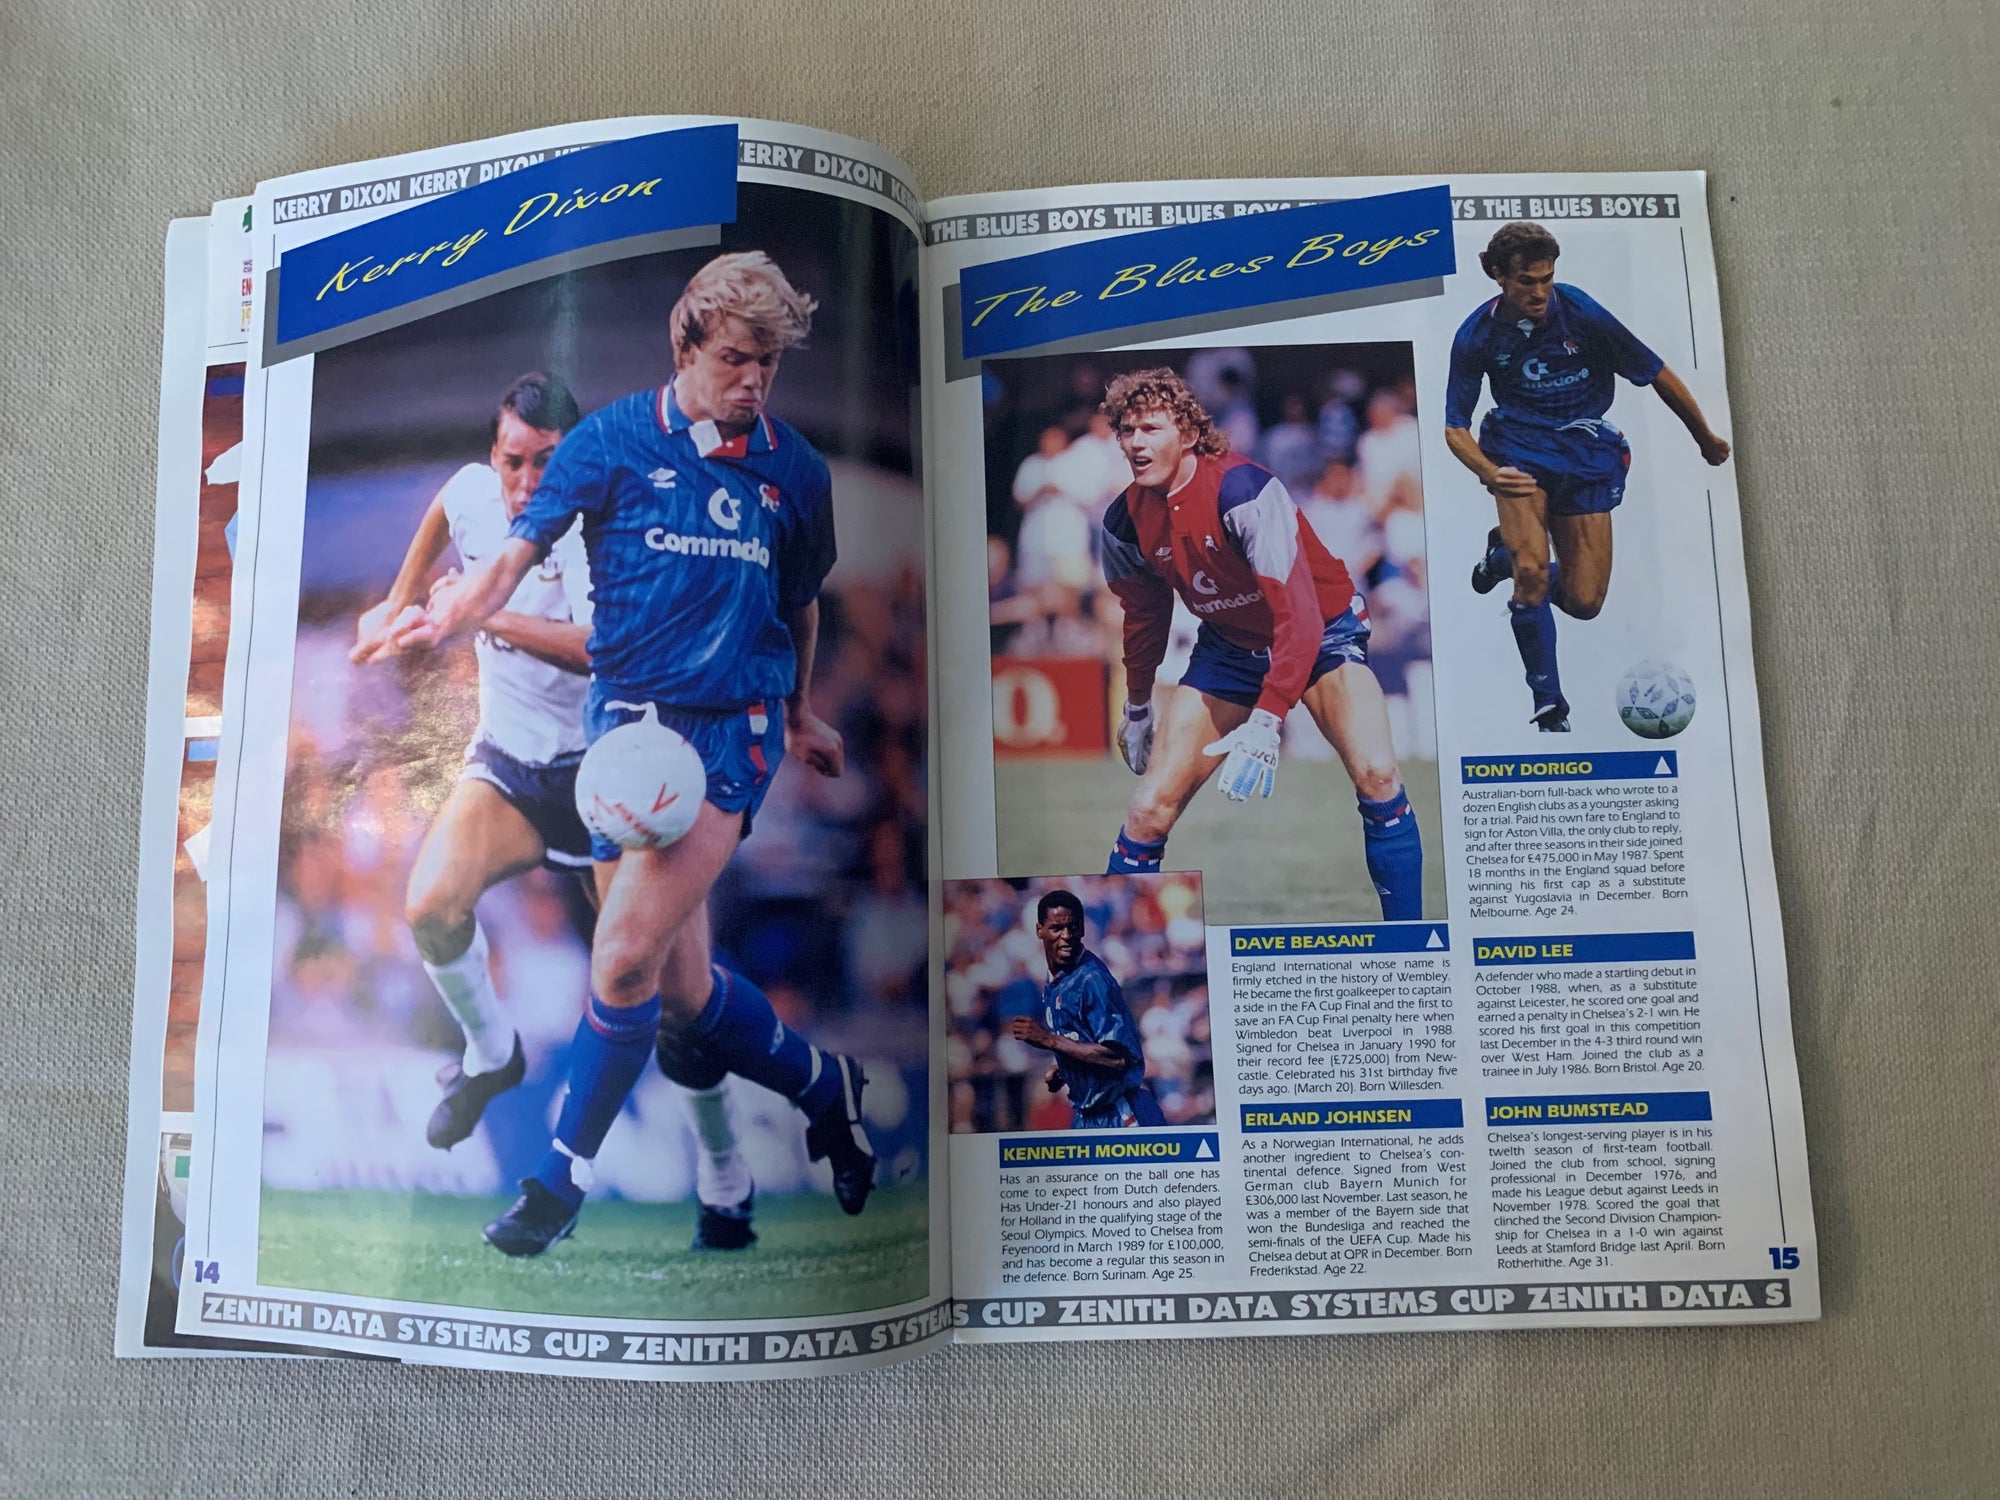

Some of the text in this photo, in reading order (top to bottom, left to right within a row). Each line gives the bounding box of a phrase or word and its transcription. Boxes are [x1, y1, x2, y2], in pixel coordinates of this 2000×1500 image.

[275, 192, 333, 222] KERRY
[340, 180, 400, 210] DIXON
[410, 166, 471, 198] KERRY
[815, 152, 884, 192] DIXON
[931, 219, 968, 242] THE
[976, 213, 1040, 237] BLUES
[1048, 208, 1106, 231] BOYS
[1114, 206, 1153, 227] THE
[1161, 203, 1225, 225] BLUES
[1483, 199, 1522, 218] THE
[1529, 197, 1593, 218] BLUES
[1600, 197, 1658, 217] BOYS
[1664, 197, 1676, 216] T
[316, 178, 662, 300] Kerry Dixon
[971, 229, 1440, 327] The Blues Boys
[1464, 761, 1593, 778] TONY DORIGO
[1462, 789, 1545, 800] Australian-born
[1548, 787, 1593, 797] full-back
[1596, 786, 1620, 796] who
[1622, 786, 1654, 794] wrote
[1658, 786, 1669, 794] to
[1463, 797, 1679, 814] dozen English clubs as a youngster asking
[1470, 905, 1577, 918] Melbourne. Age 24.
[1234, 934, 1375, 950] DAVE BEASANT
[1478, 943, 1574, 960] DAVID LEE
[1232, 958, 1450, 974] England International whose name is
[1474, 972, 1484, 982] A
[1486, 971, 1534, 982] defender
[1536, 970, 1561, 980] who
[1564, 969, 1593, 979] made
[1604, 968, 1648, 979] startling
[1651, 967, 1684, 977] debut
[1686, 966, 1696, 975] in
[1232, 971, 1450, 988] firmly etched in the history of Wembley.
[1476, 979, 1697, 996] October 1988, when, as a substitute
[1245, 1109, 1412, 1126] ERLAND JOHNSEN
[1490, 1102, 1649, 1120] JOHN BUMSTEAD
[1242, 1134, 1464, 1150] As a Norwegian International, he adds
[1543, 1129, 1627, 1144] longest-serving
[1632, 1129, 1665, 1141] player
[1670, 1128, 1678, 1138] is
[1682, 1128, 1692, 1138] in
[1697, 1127, 1712, 1137] his
[1003, 1142, 1181, 1161] KENNETH MONKOU
[1534, 1146, 1572, 1155] season
[1582, 1143, 1593, 1154] of
[1604, 1143, 1656, 1153] first-team
[1666, 1141, 1713, 1152] football.
[1243, 1153, 1286, 1164] another
[1294, 1150, 1350, 1164] ingredient
[1359, 1152, 1371, 1161] to
[1440, 1150, 1464, 1158] con-
[1000, 1168, 1220, 1185] Has an assurance on the ball one has
[1000, 1182, 1220, 1199] come to expect from Dutch defenders.
[1498, 1256, 1613, 1270] Rotherhithe. Age 31.
[1768, 1247, 1800, 1270] 15
[194, 1260, 220, 1284] 14
[1002, 1268, 1195, 1283] the defence. Born Surinam. Age 25.
[1250, 1263, 1367, 1277] Frederikstad. Age 22.
[203, 1282, 1785, 1362] ZENITH DATA SYSTEMS CUP ZENITH DATA SYSTEMS CUP ZENITH DATA SYSTEMS CUP ZENITH DATA S
